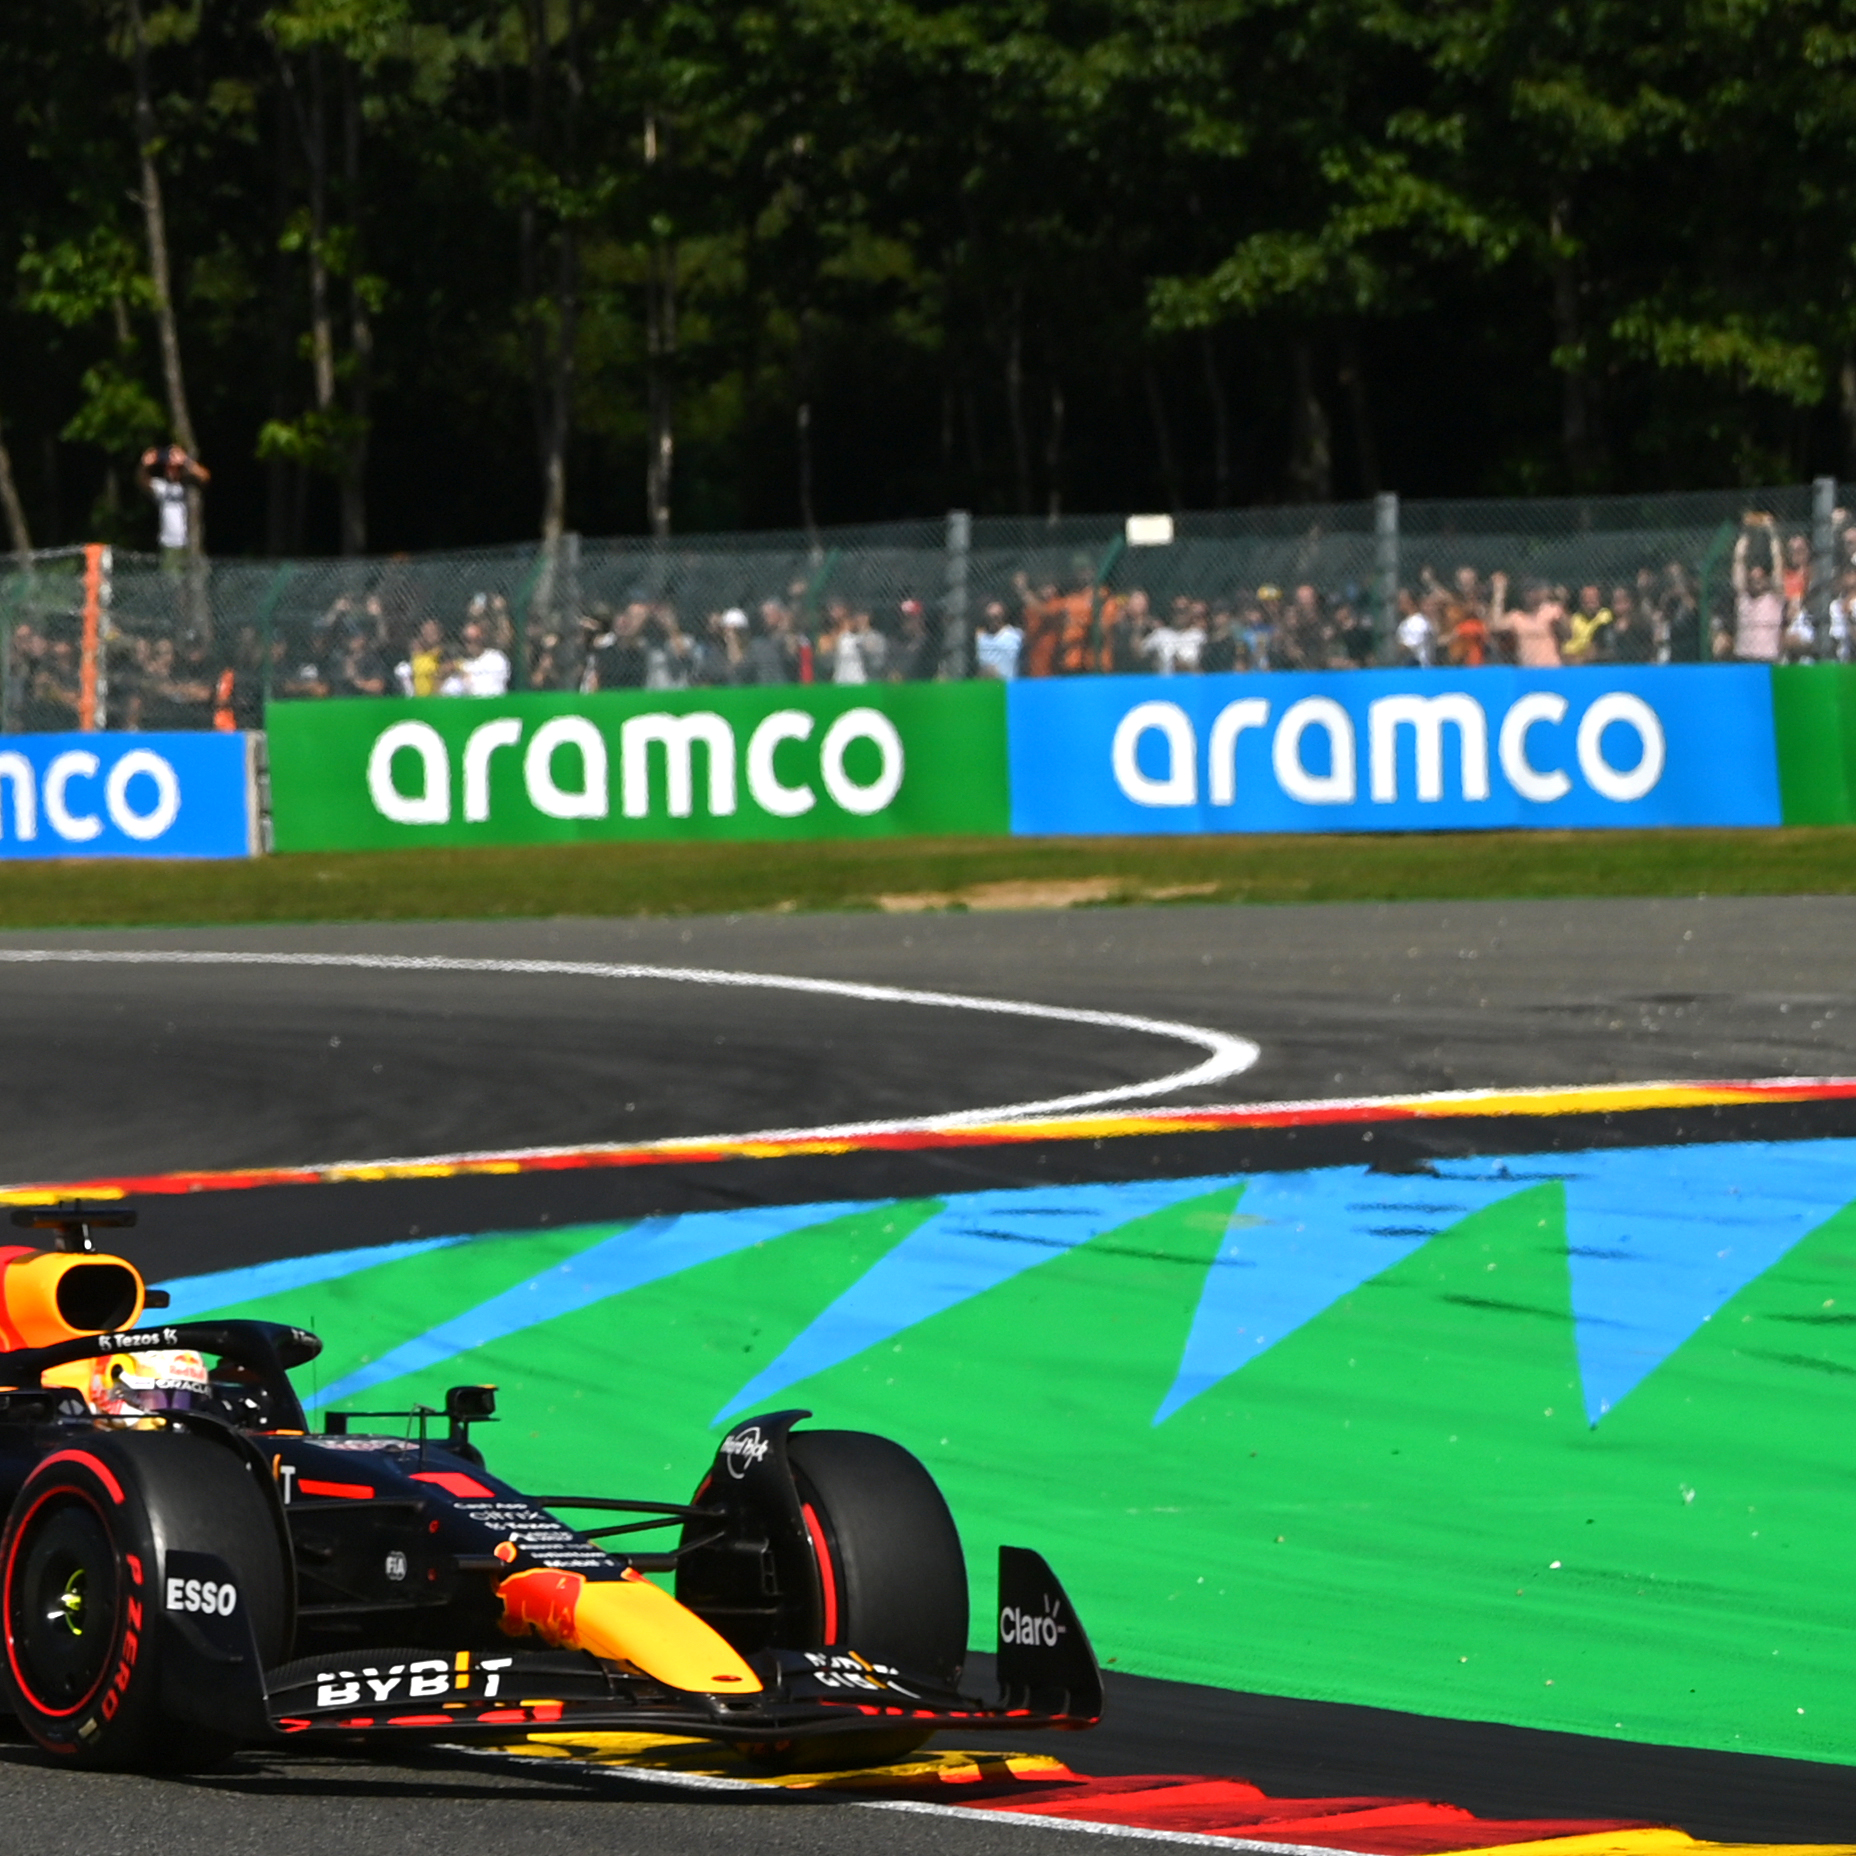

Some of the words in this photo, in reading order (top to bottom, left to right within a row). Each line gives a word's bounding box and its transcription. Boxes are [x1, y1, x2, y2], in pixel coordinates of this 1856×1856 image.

[366, 707, 905, 825] aramco
[1112, 692, 1665, 807] aramco
[114, 1333, 160, 1348] Tezos
[126, 1553, 144, 1586] P
[166, 1577, 237, 1617] ESSO
[1000, 1606, 1057, 1647] Claro
[101, 1596, 143, 1722] ZERO
[317, 1651, 513, 1707] BYBIT
